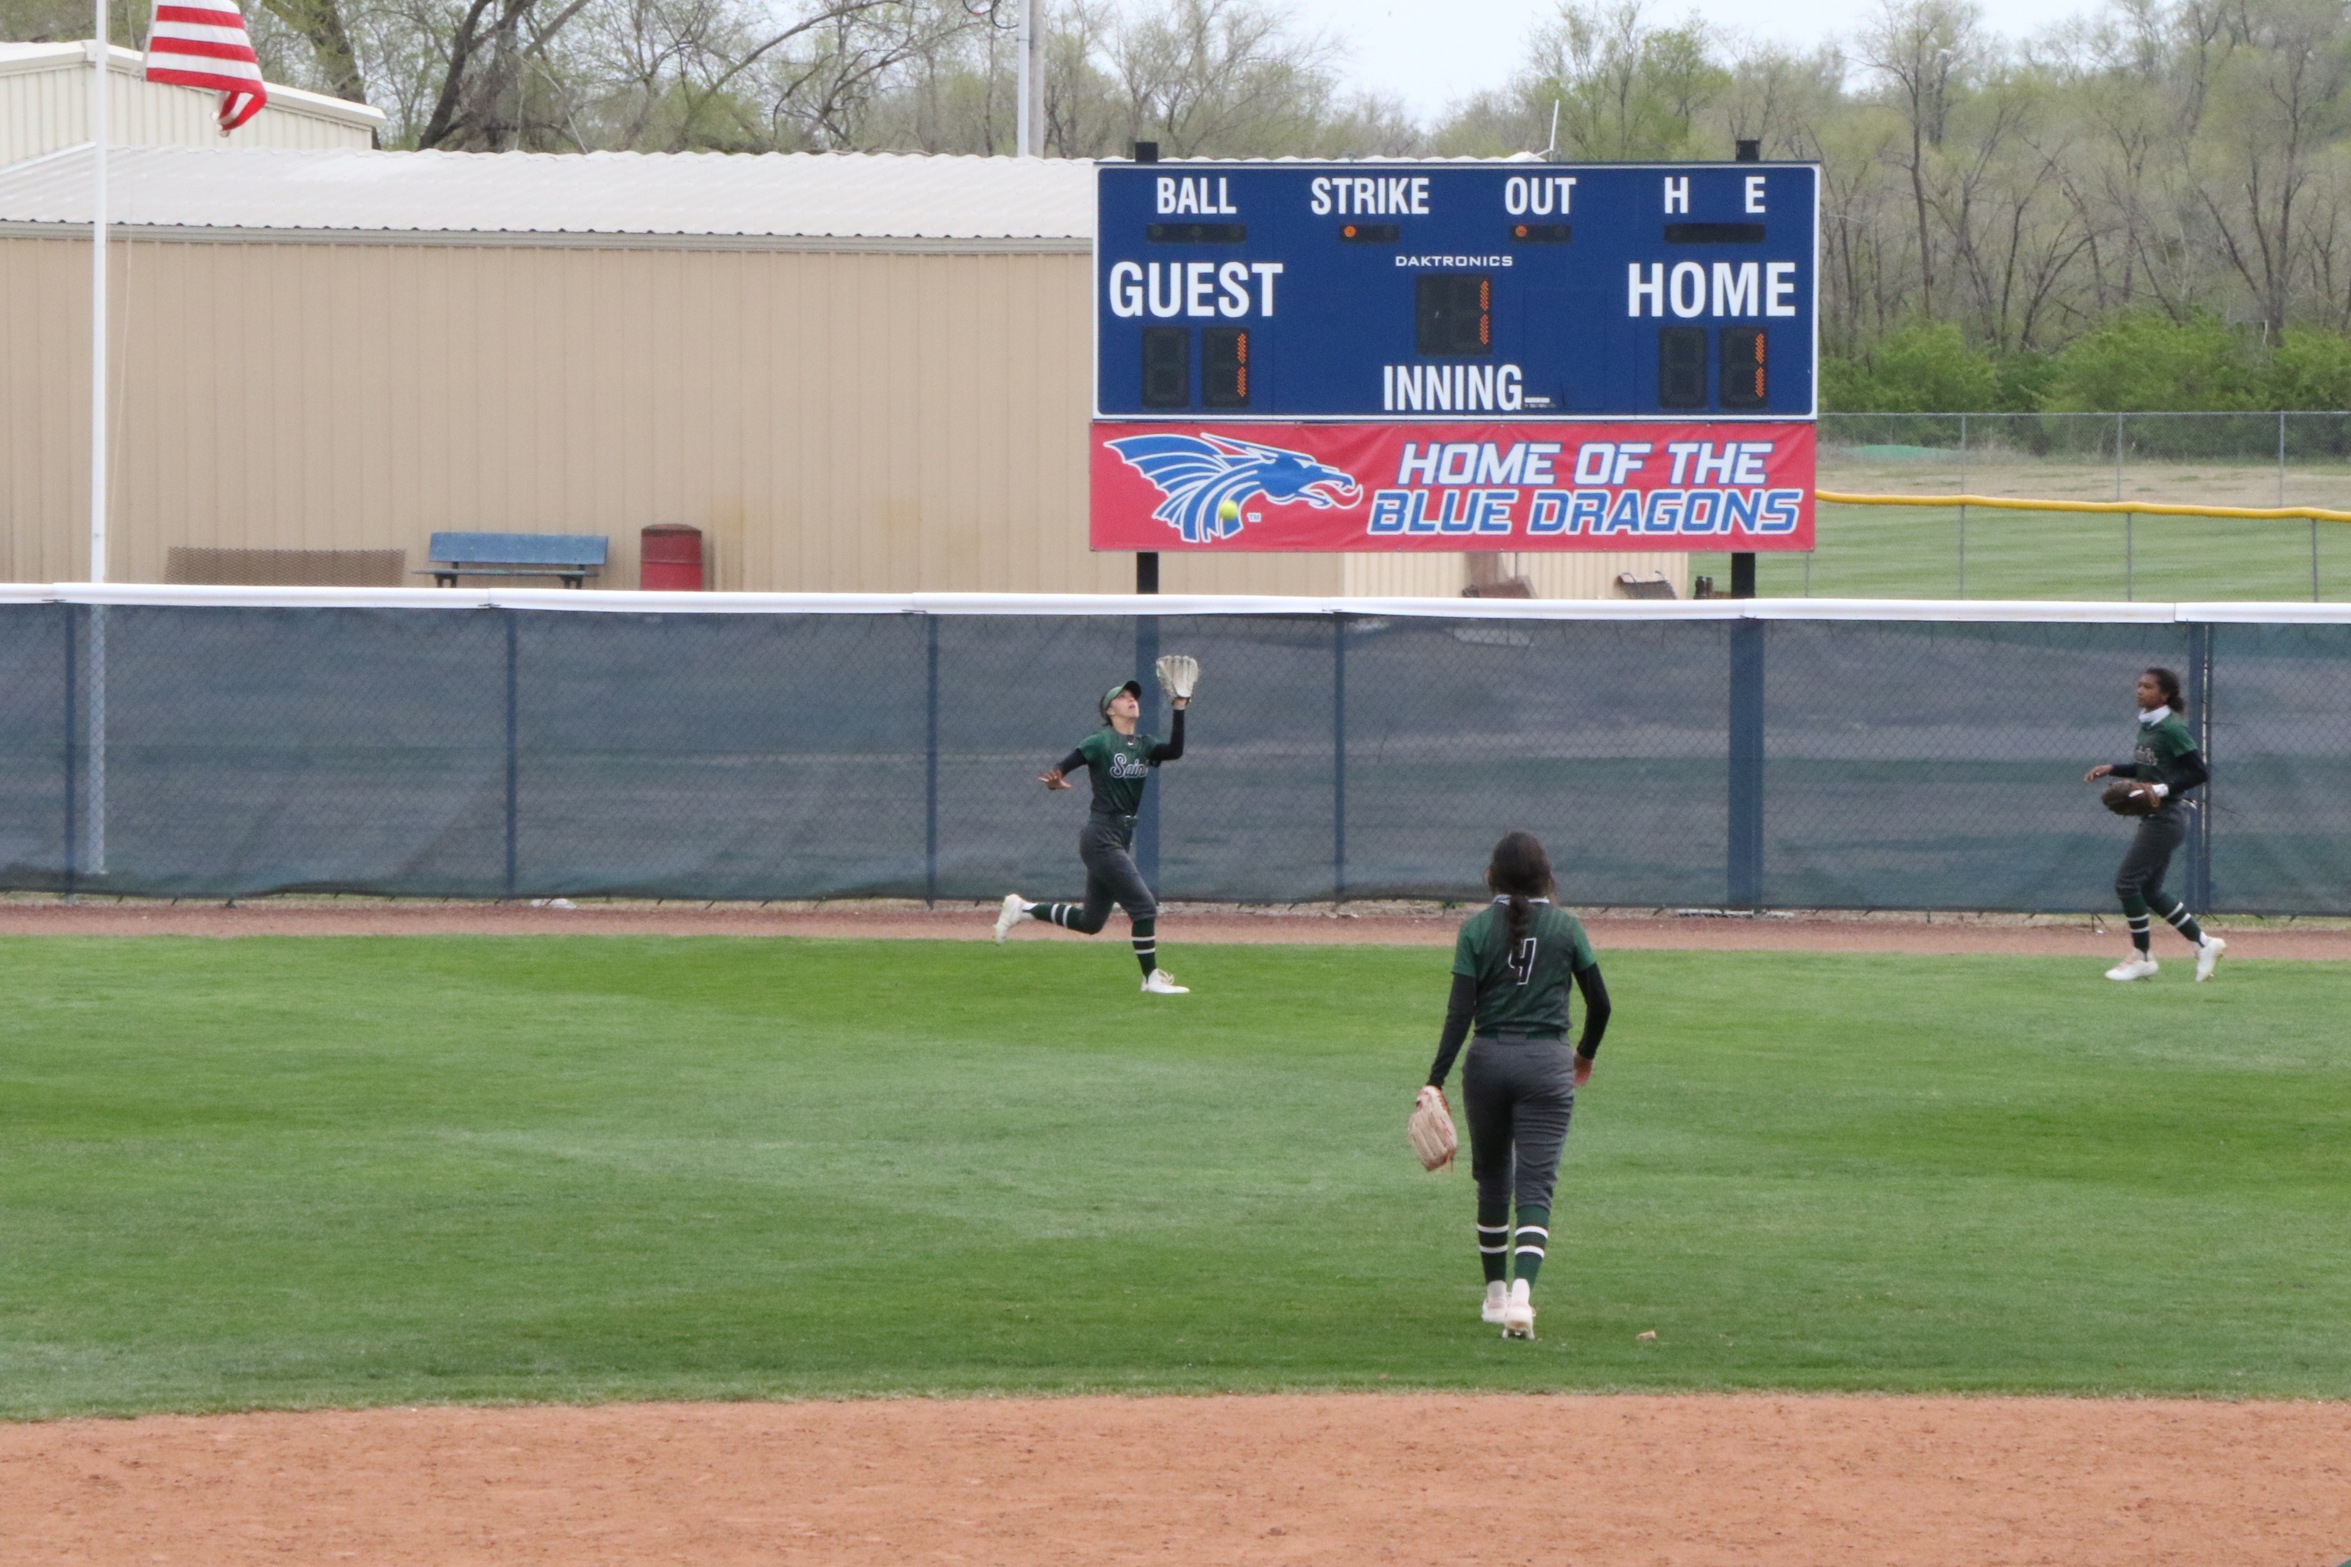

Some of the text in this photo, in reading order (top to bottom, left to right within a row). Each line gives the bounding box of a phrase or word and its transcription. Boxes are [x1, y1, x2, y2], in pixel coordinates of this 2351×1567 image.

[1157, 178, 1236, 214] BALL
[1311, 177, 1429, 214] STRIKE
[1505, 177, 1576, 215] OUT
[1665, 177, 1766, 214] H E
[1395, 255, 1513, 268] DAKTRONICS
[1110, 262, 1284, 318] GUEST
[1480, 280, 1490, 344] 1
[1628, 262, 1796, 318] HOME
[1237, 333, 1246, 397] 1
[1384, 365, 1523, 410] INNING
[1755, 333, 1765, 397] 1
[1397, 441, 1775, 486] HOME OF THE
[1367, 487, 1804, 536] BLUE DRAGONS
